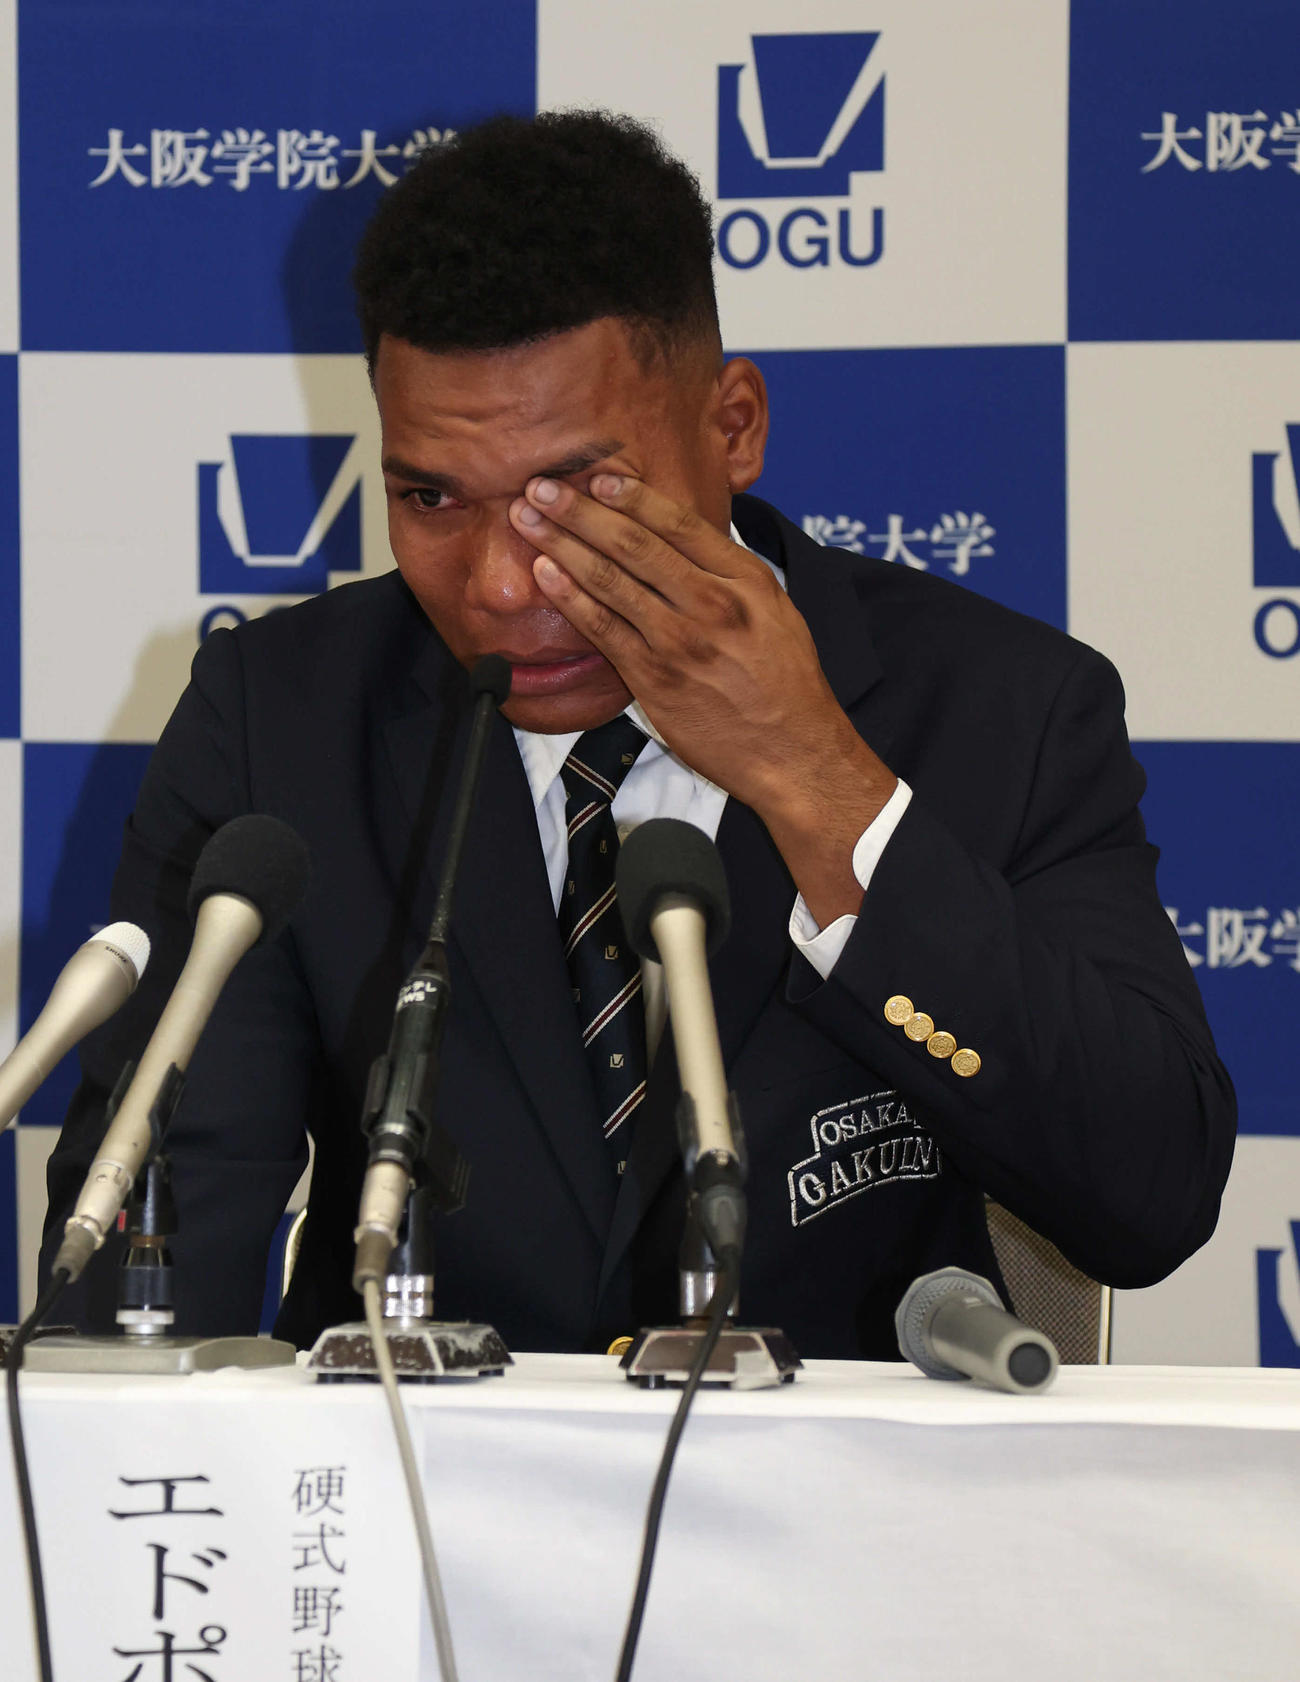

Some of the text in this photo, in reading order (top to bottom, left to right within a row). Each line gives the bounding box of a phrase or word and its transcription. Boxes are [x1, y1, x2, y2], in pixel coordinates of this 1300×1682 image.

[717, 206, 884, 270] OGU
[819, 1101, 913, 1146] OSAKA
[798, 1136, 933, 1207] GAKUIN
[106, 1474, 228, 1682] エドポ
[290, 1465, 347, 1682] 硬式野球
